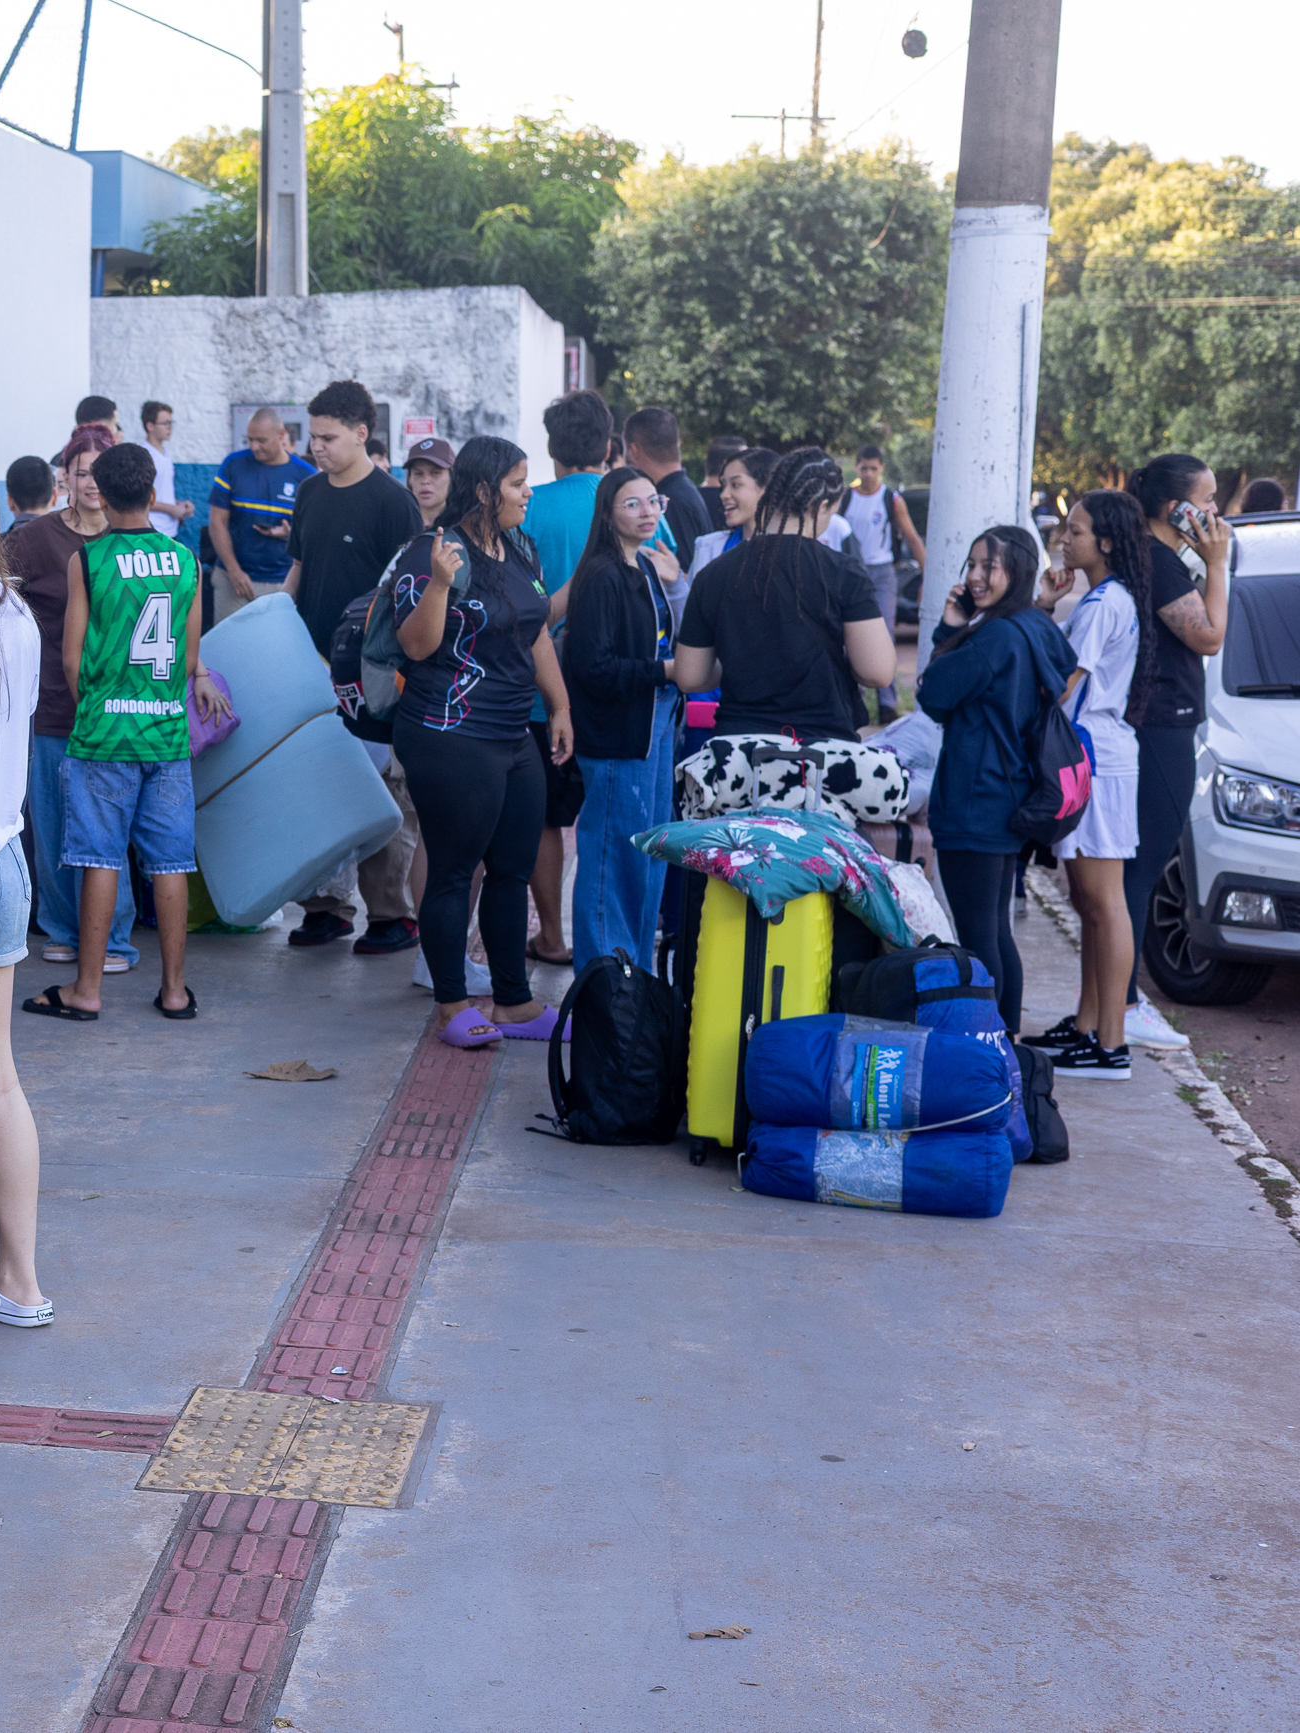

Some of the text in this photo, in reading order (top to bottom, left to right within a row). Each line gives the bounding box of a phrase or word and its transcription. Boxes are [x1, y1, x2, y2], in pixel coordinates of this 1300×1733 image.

[115, 549, 181, 579] VÔLEI
[129, 592, 176, 680] 4
[878, 1071, 893, 1108] Mont
